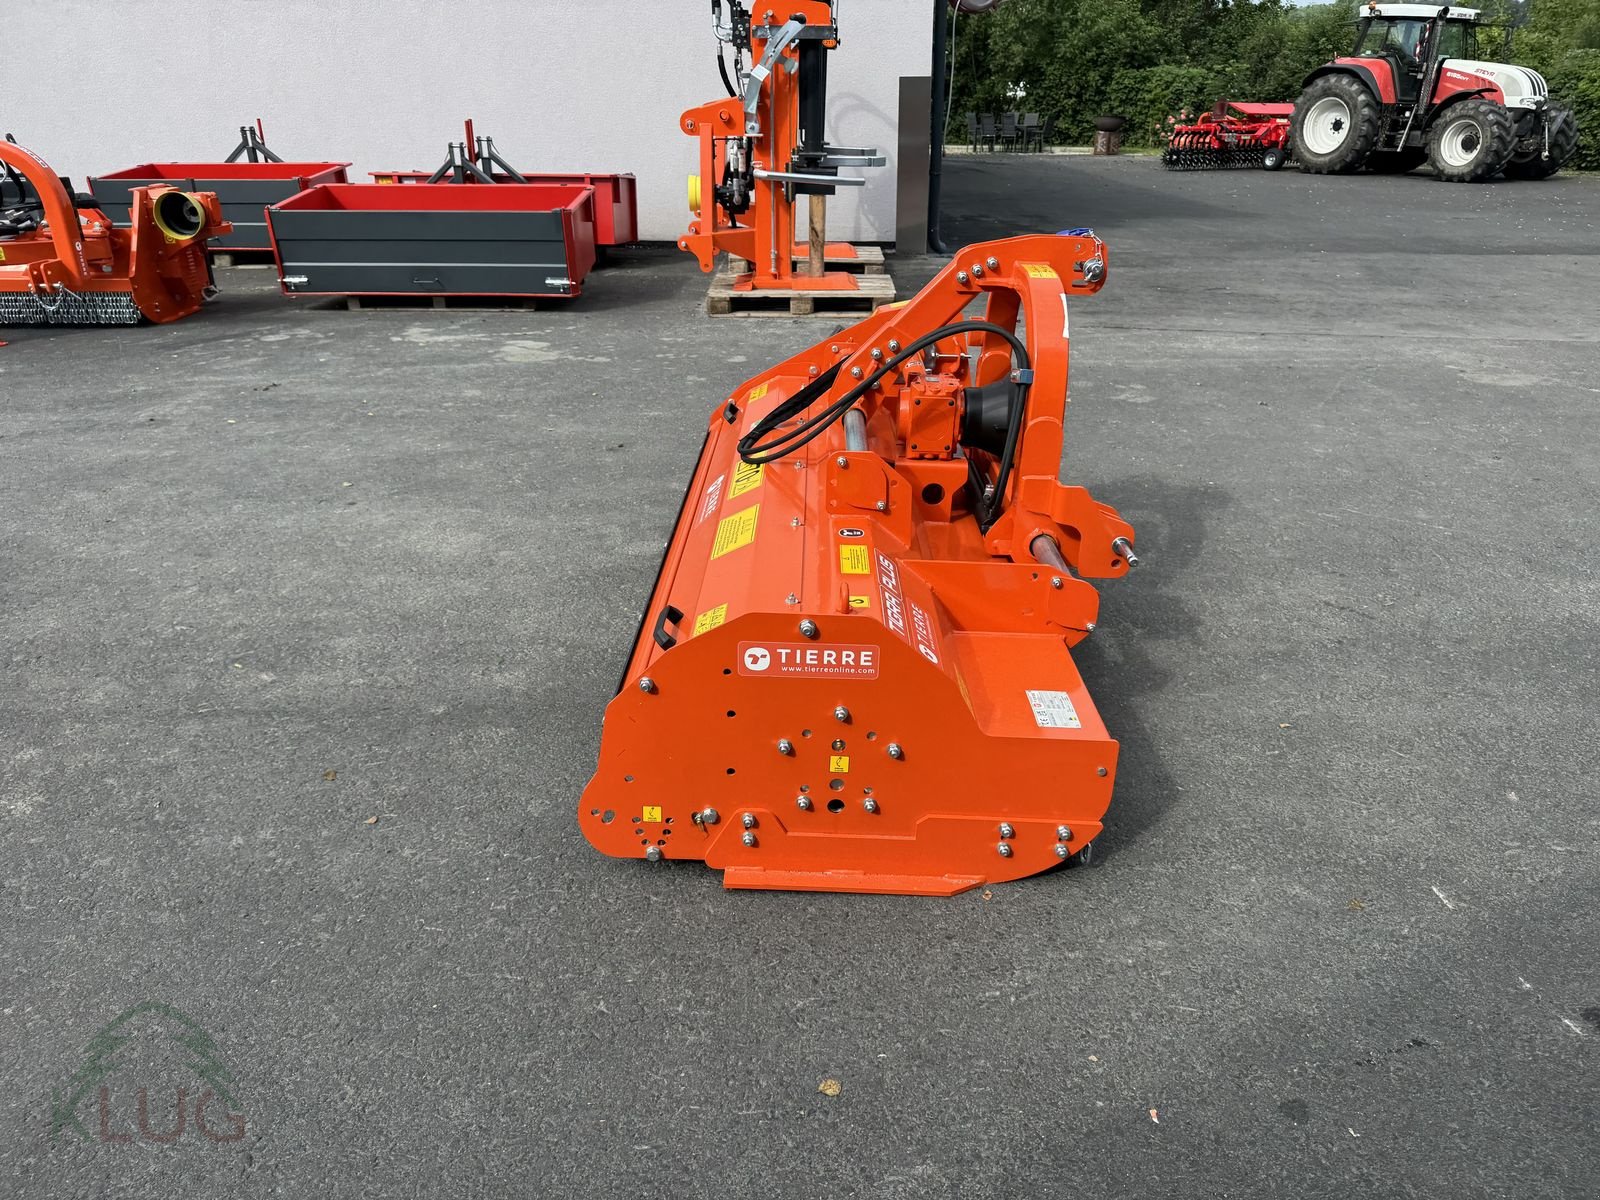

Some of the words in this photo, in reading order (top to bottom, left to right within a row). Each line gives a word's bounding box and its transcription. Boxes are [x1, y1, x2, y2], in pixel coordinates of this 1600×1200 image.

[879, 554, 898, 594] PLUS
[884, 591, 905, 637] TIGRA
[911, 603, 929, 645] TIERRE
[777, 648, 873, 666] TIERRE
[781, 666, 875, 674] www.tierreonline.com
